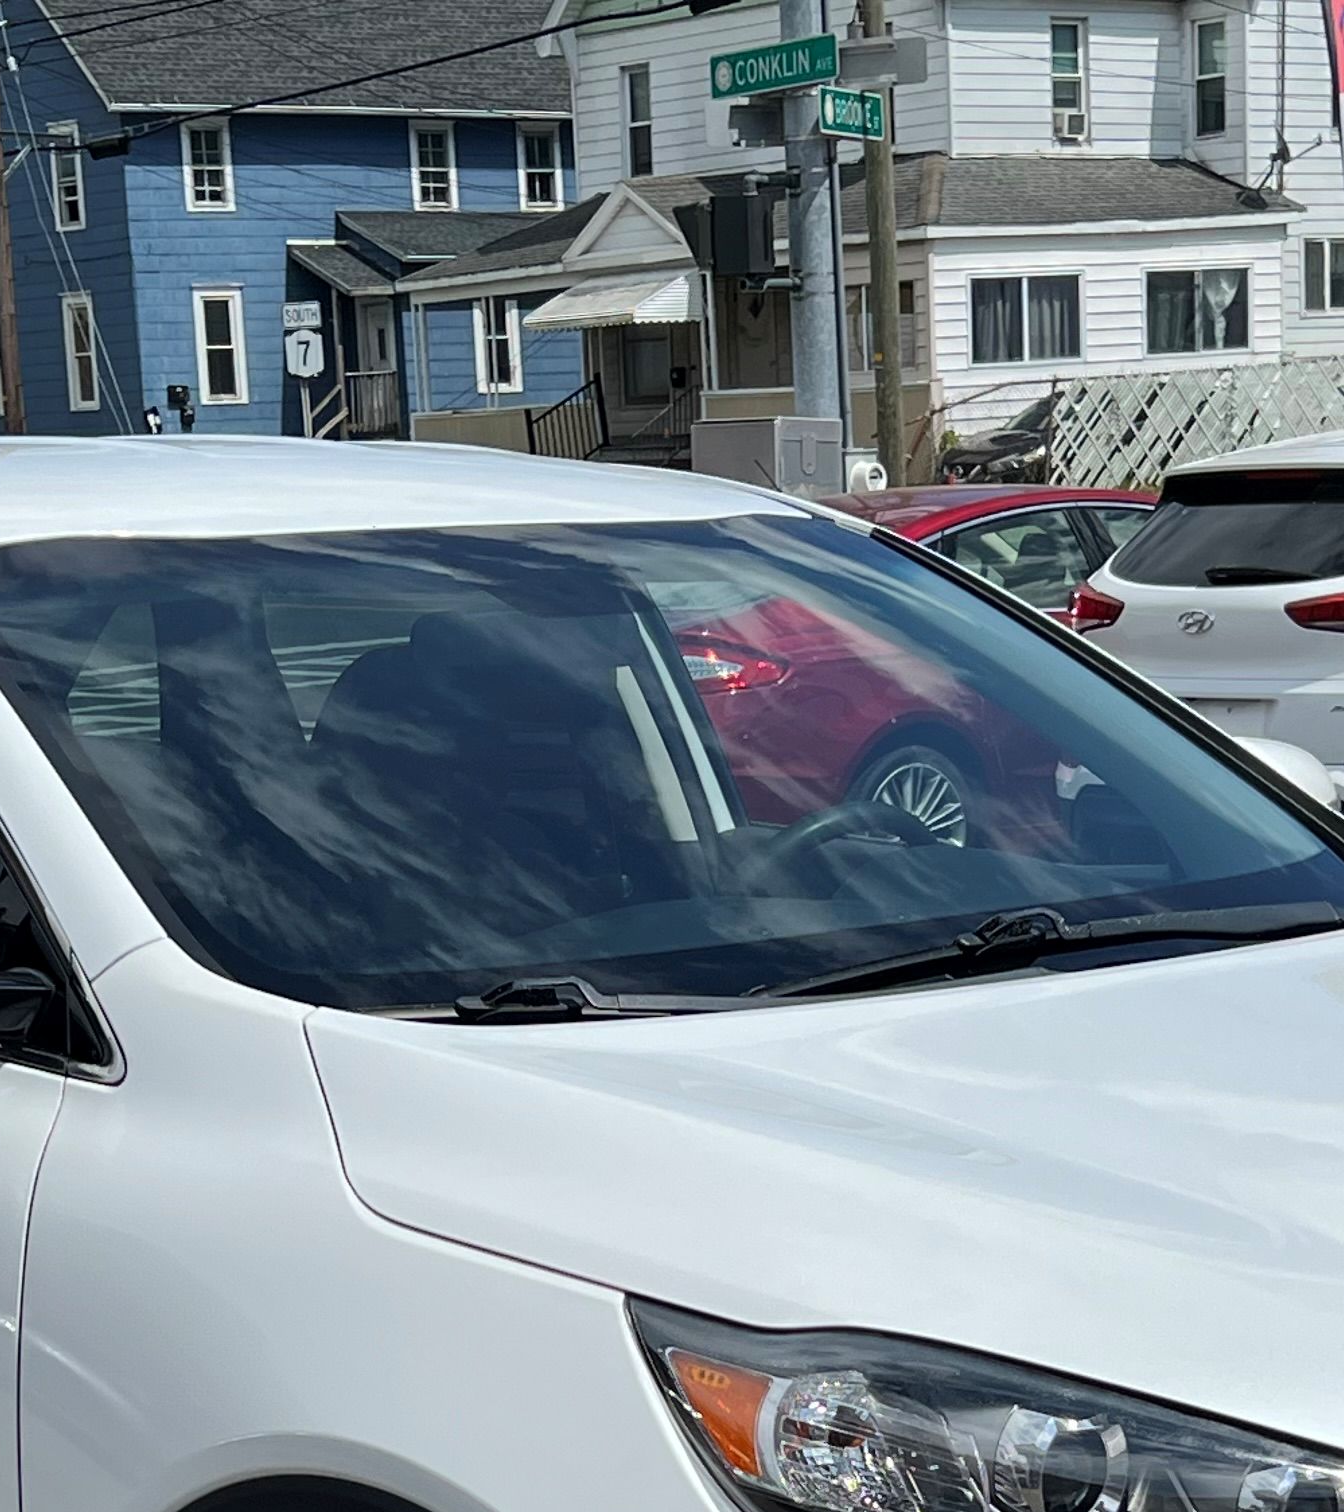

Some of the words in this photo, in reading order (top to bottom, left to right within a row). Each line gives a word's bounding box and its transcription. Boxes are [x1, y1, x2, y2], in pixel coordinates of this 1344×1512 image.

[735, 48, 810, 86] CONKLIN
[815, 56, 834, 72] AVE
[285, 308, 318, 323] SOUTH
[297, 340, 310, 366] 7
